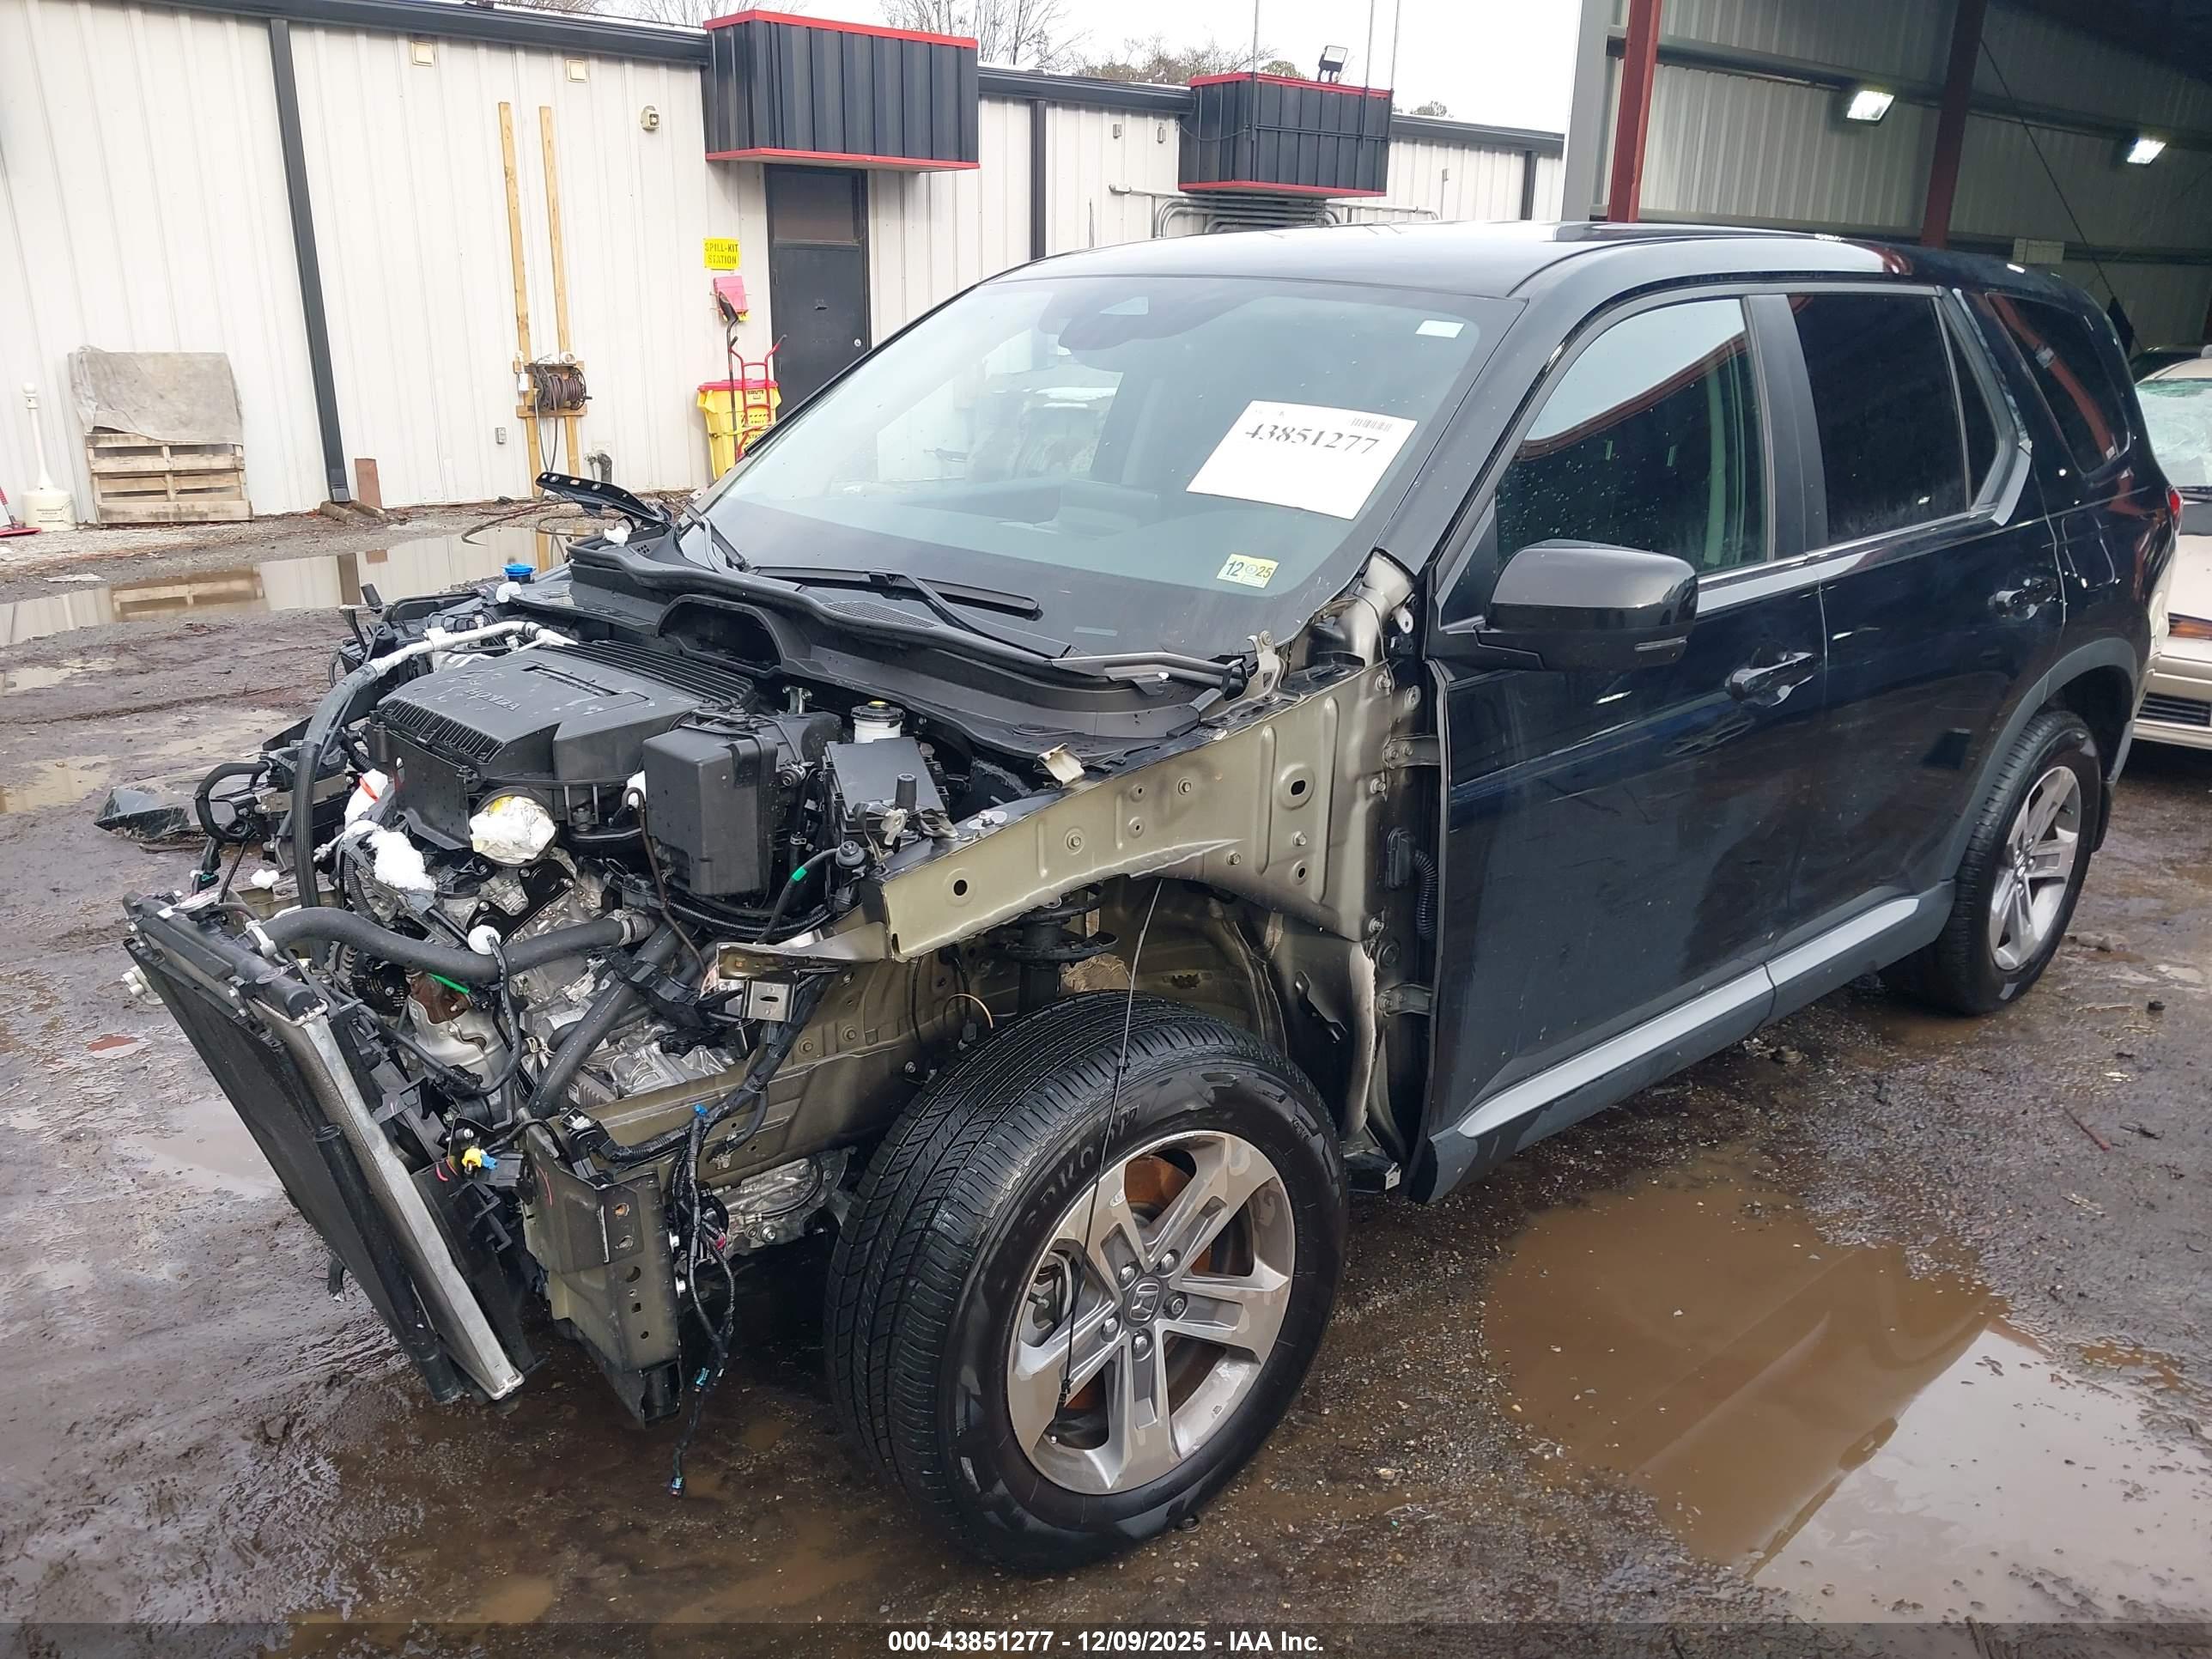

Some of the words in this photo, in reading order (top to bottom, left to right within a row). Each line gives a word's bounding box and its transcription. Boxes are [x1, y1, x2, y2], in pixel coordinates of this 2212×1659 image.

[704, 242, 738, 253] SPILL-KIT
[708, 255, 738, 264] STATION
[1245, 422, 1380, 454] 43851277
[1226, 561, 1244, 576] 12
[1255, 566, 1273, 578] 25
